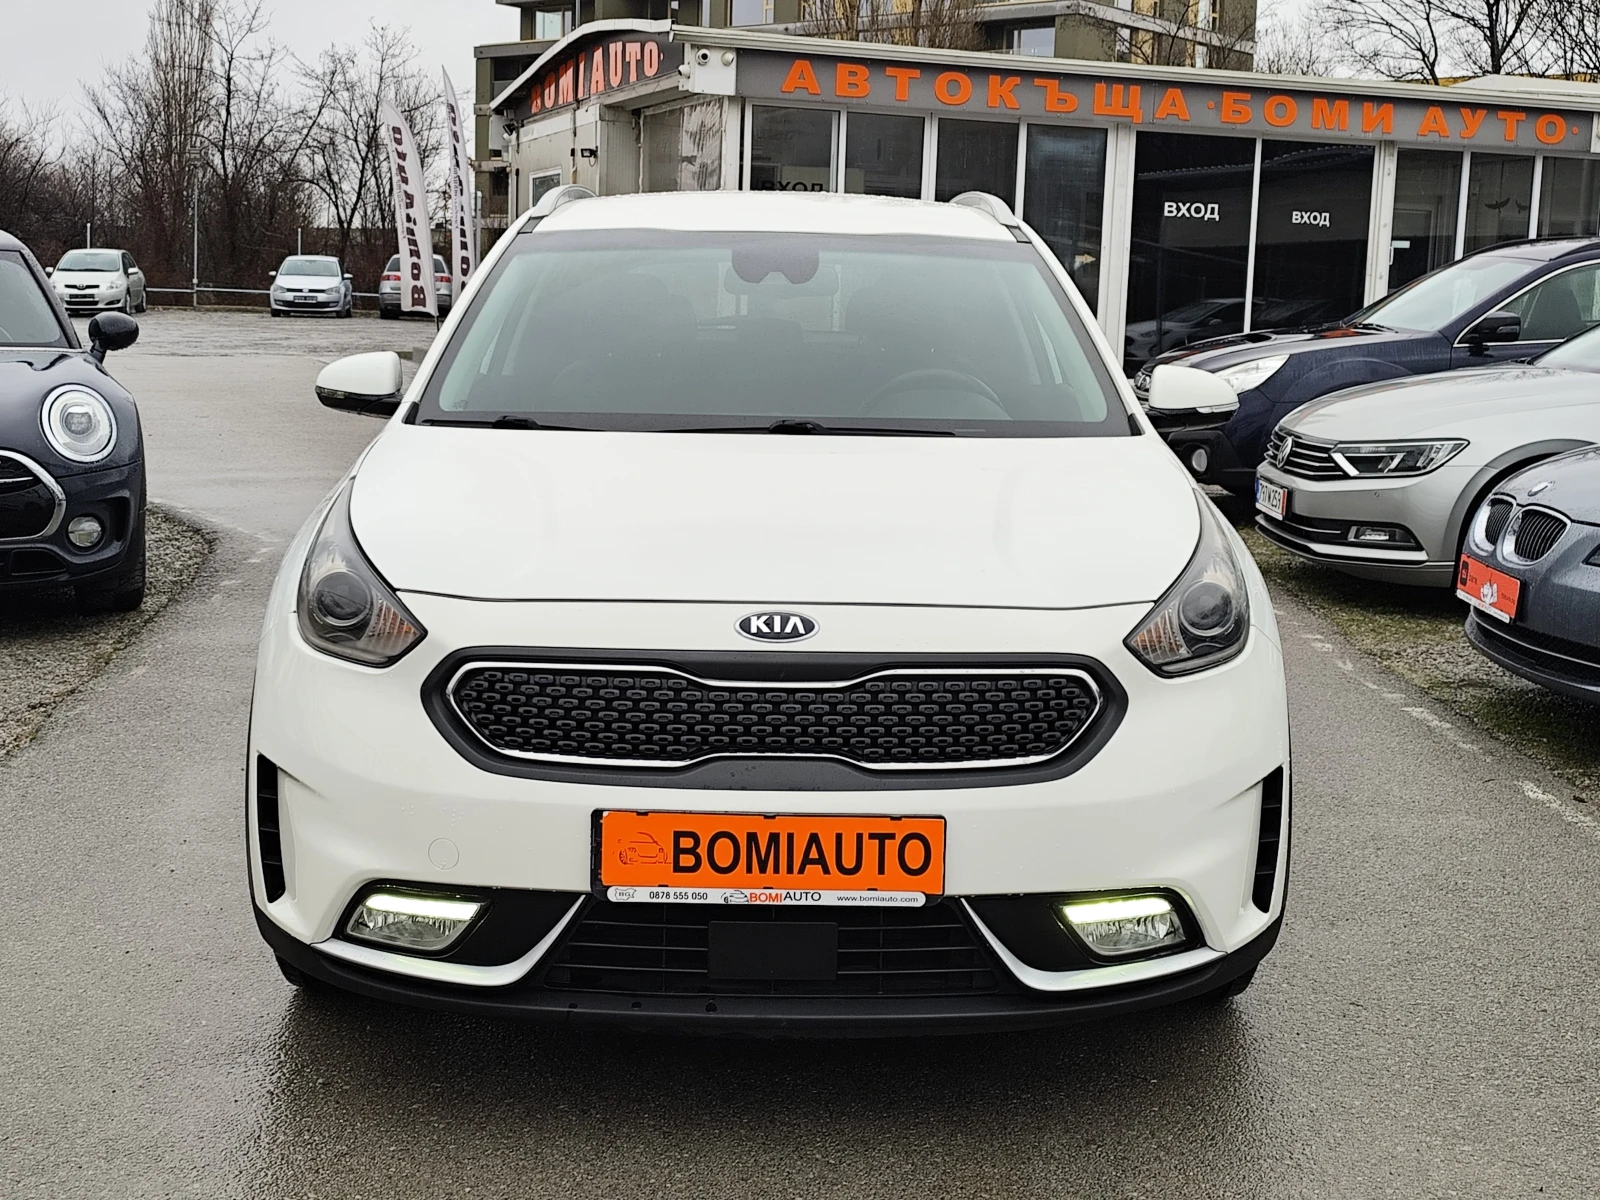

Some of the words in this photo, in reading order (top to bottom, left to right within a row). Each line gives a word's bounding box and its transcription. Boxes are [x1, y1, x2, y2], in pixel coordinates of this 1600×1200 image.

[780, 59, 1191, 125] АВТОКЪЩА
[1219, 90, 1395, 134] БОМИ
[1163, 201, 1220, 222] ВХОД
[1291, 210, 1330, 228] ВХОД
[749, 615, 806, 635] KIA
[672, 830, 932, 877] BOMIAUTO
[648, 890, 671, 900] 0878
[673, 891, 689, 900] 555
[691, 891, 708, 901] 050
[836, 893, 919, 903] www.bomiauto.com
